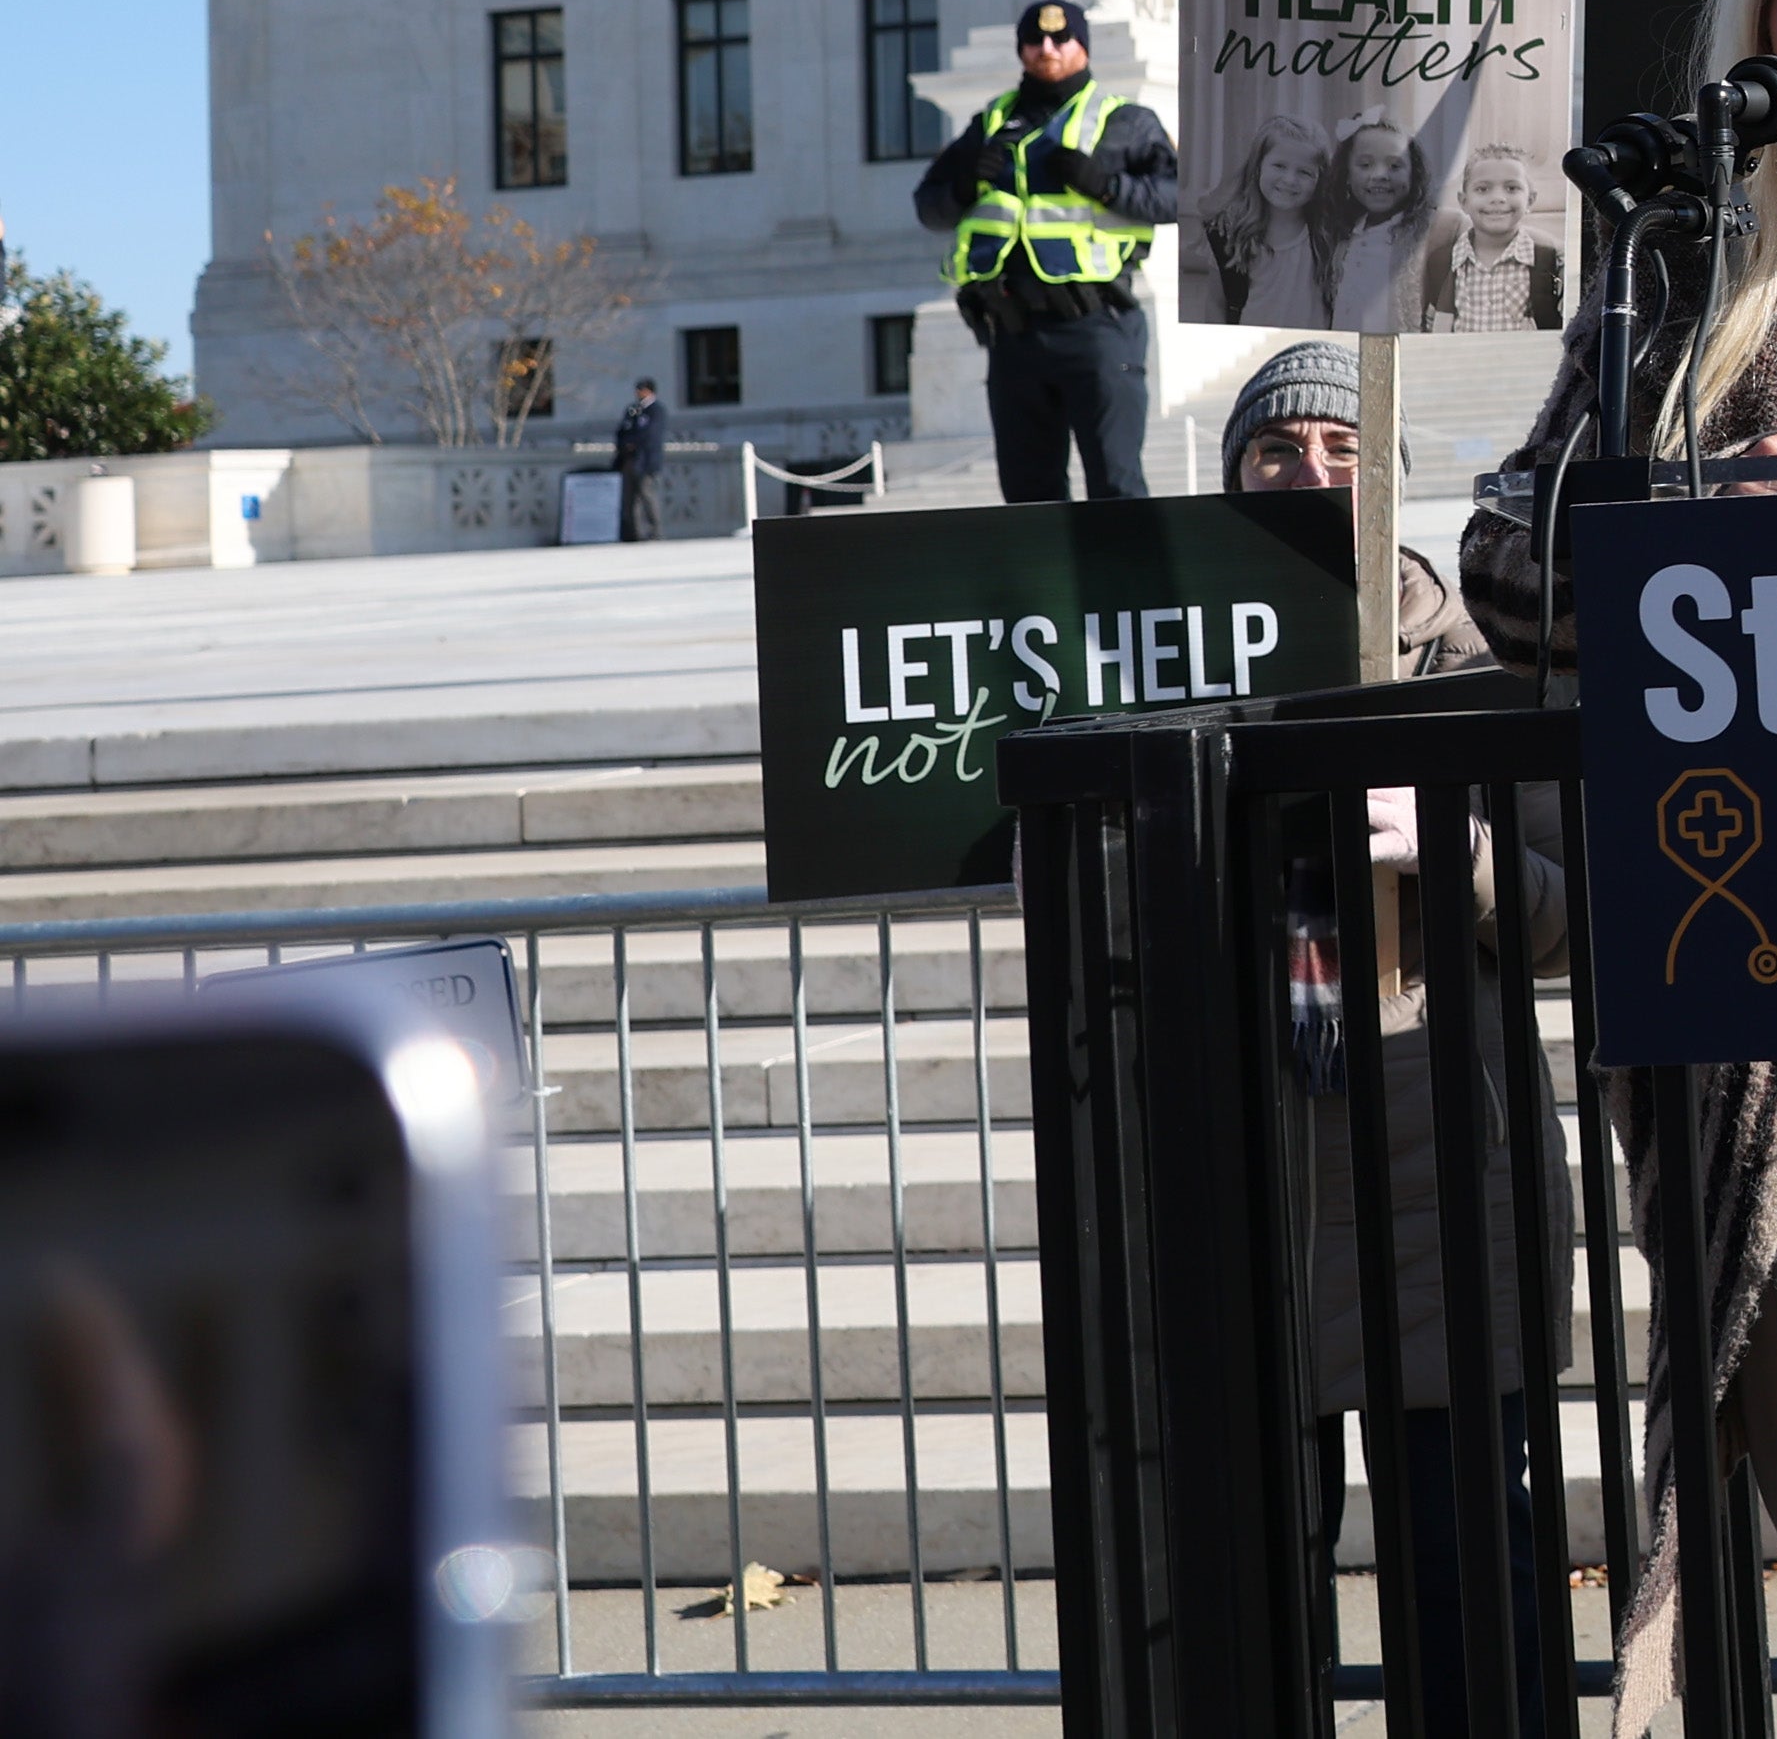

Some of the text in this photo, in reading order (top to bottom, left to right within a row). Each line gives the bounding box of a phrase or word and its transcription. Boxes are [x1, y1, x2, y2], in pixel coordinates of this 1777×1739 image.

[1213, 9, 1546, 87] matters
[841, 601, 1279, 725] LET’S HELP
[824, 687, 1008, 789] not
